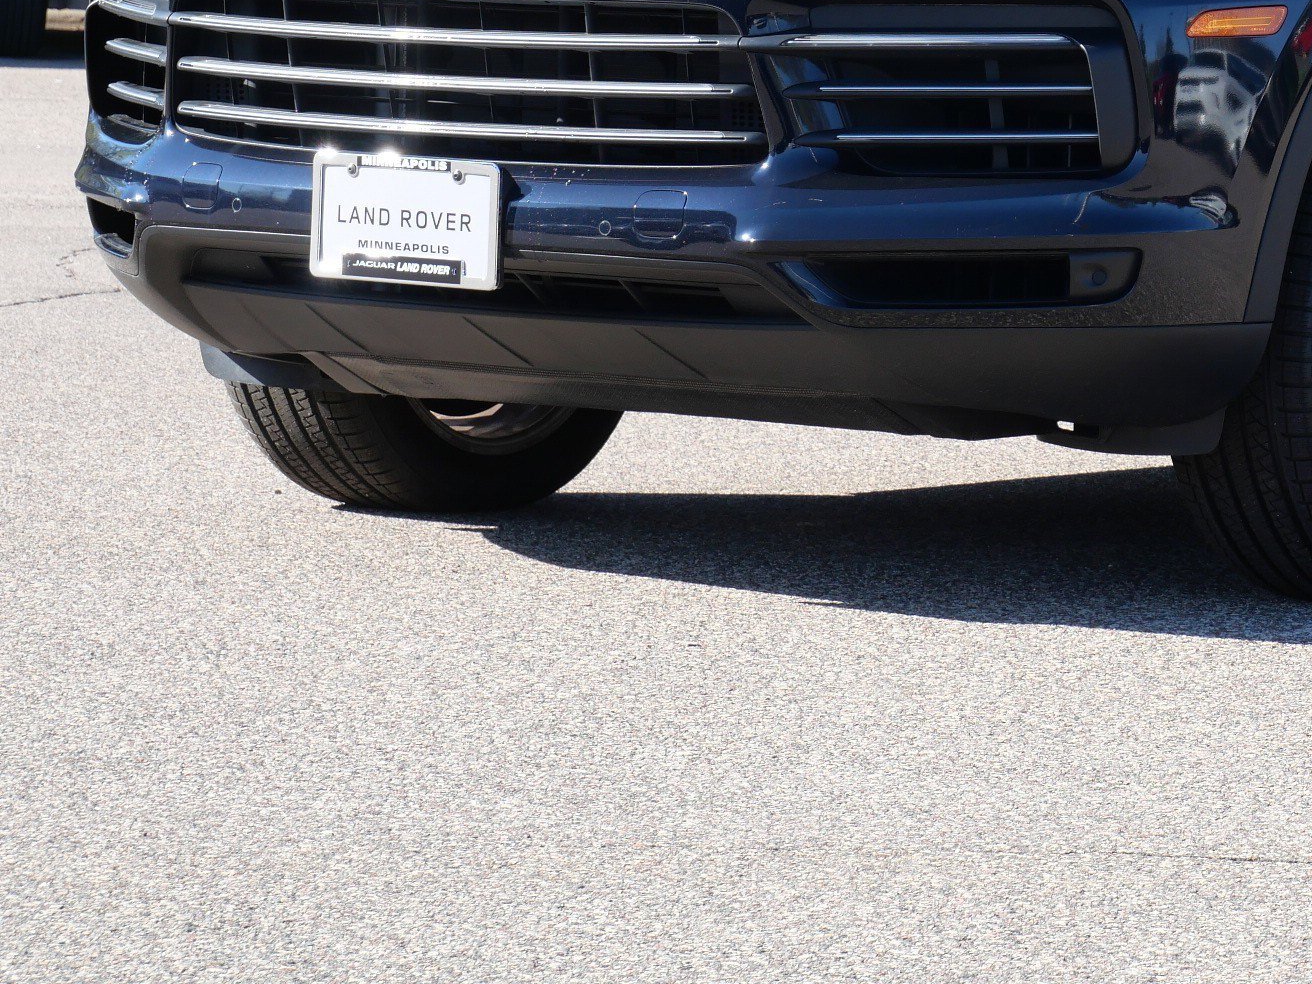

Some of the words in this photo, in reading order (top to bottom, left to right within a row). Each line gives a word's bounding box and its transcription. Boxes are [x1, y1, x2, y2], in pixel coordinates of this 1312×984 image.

[337, 204, 390, 226] LAND
[400, 209, 472, 232] ROVER
[358, 239, 449, 254] MINNEAPOLIS
[352, 259, 395, 270] JAGUAR
[396, 261, 420, 273] LAND
[420, 264, 451, 276] ROVER
